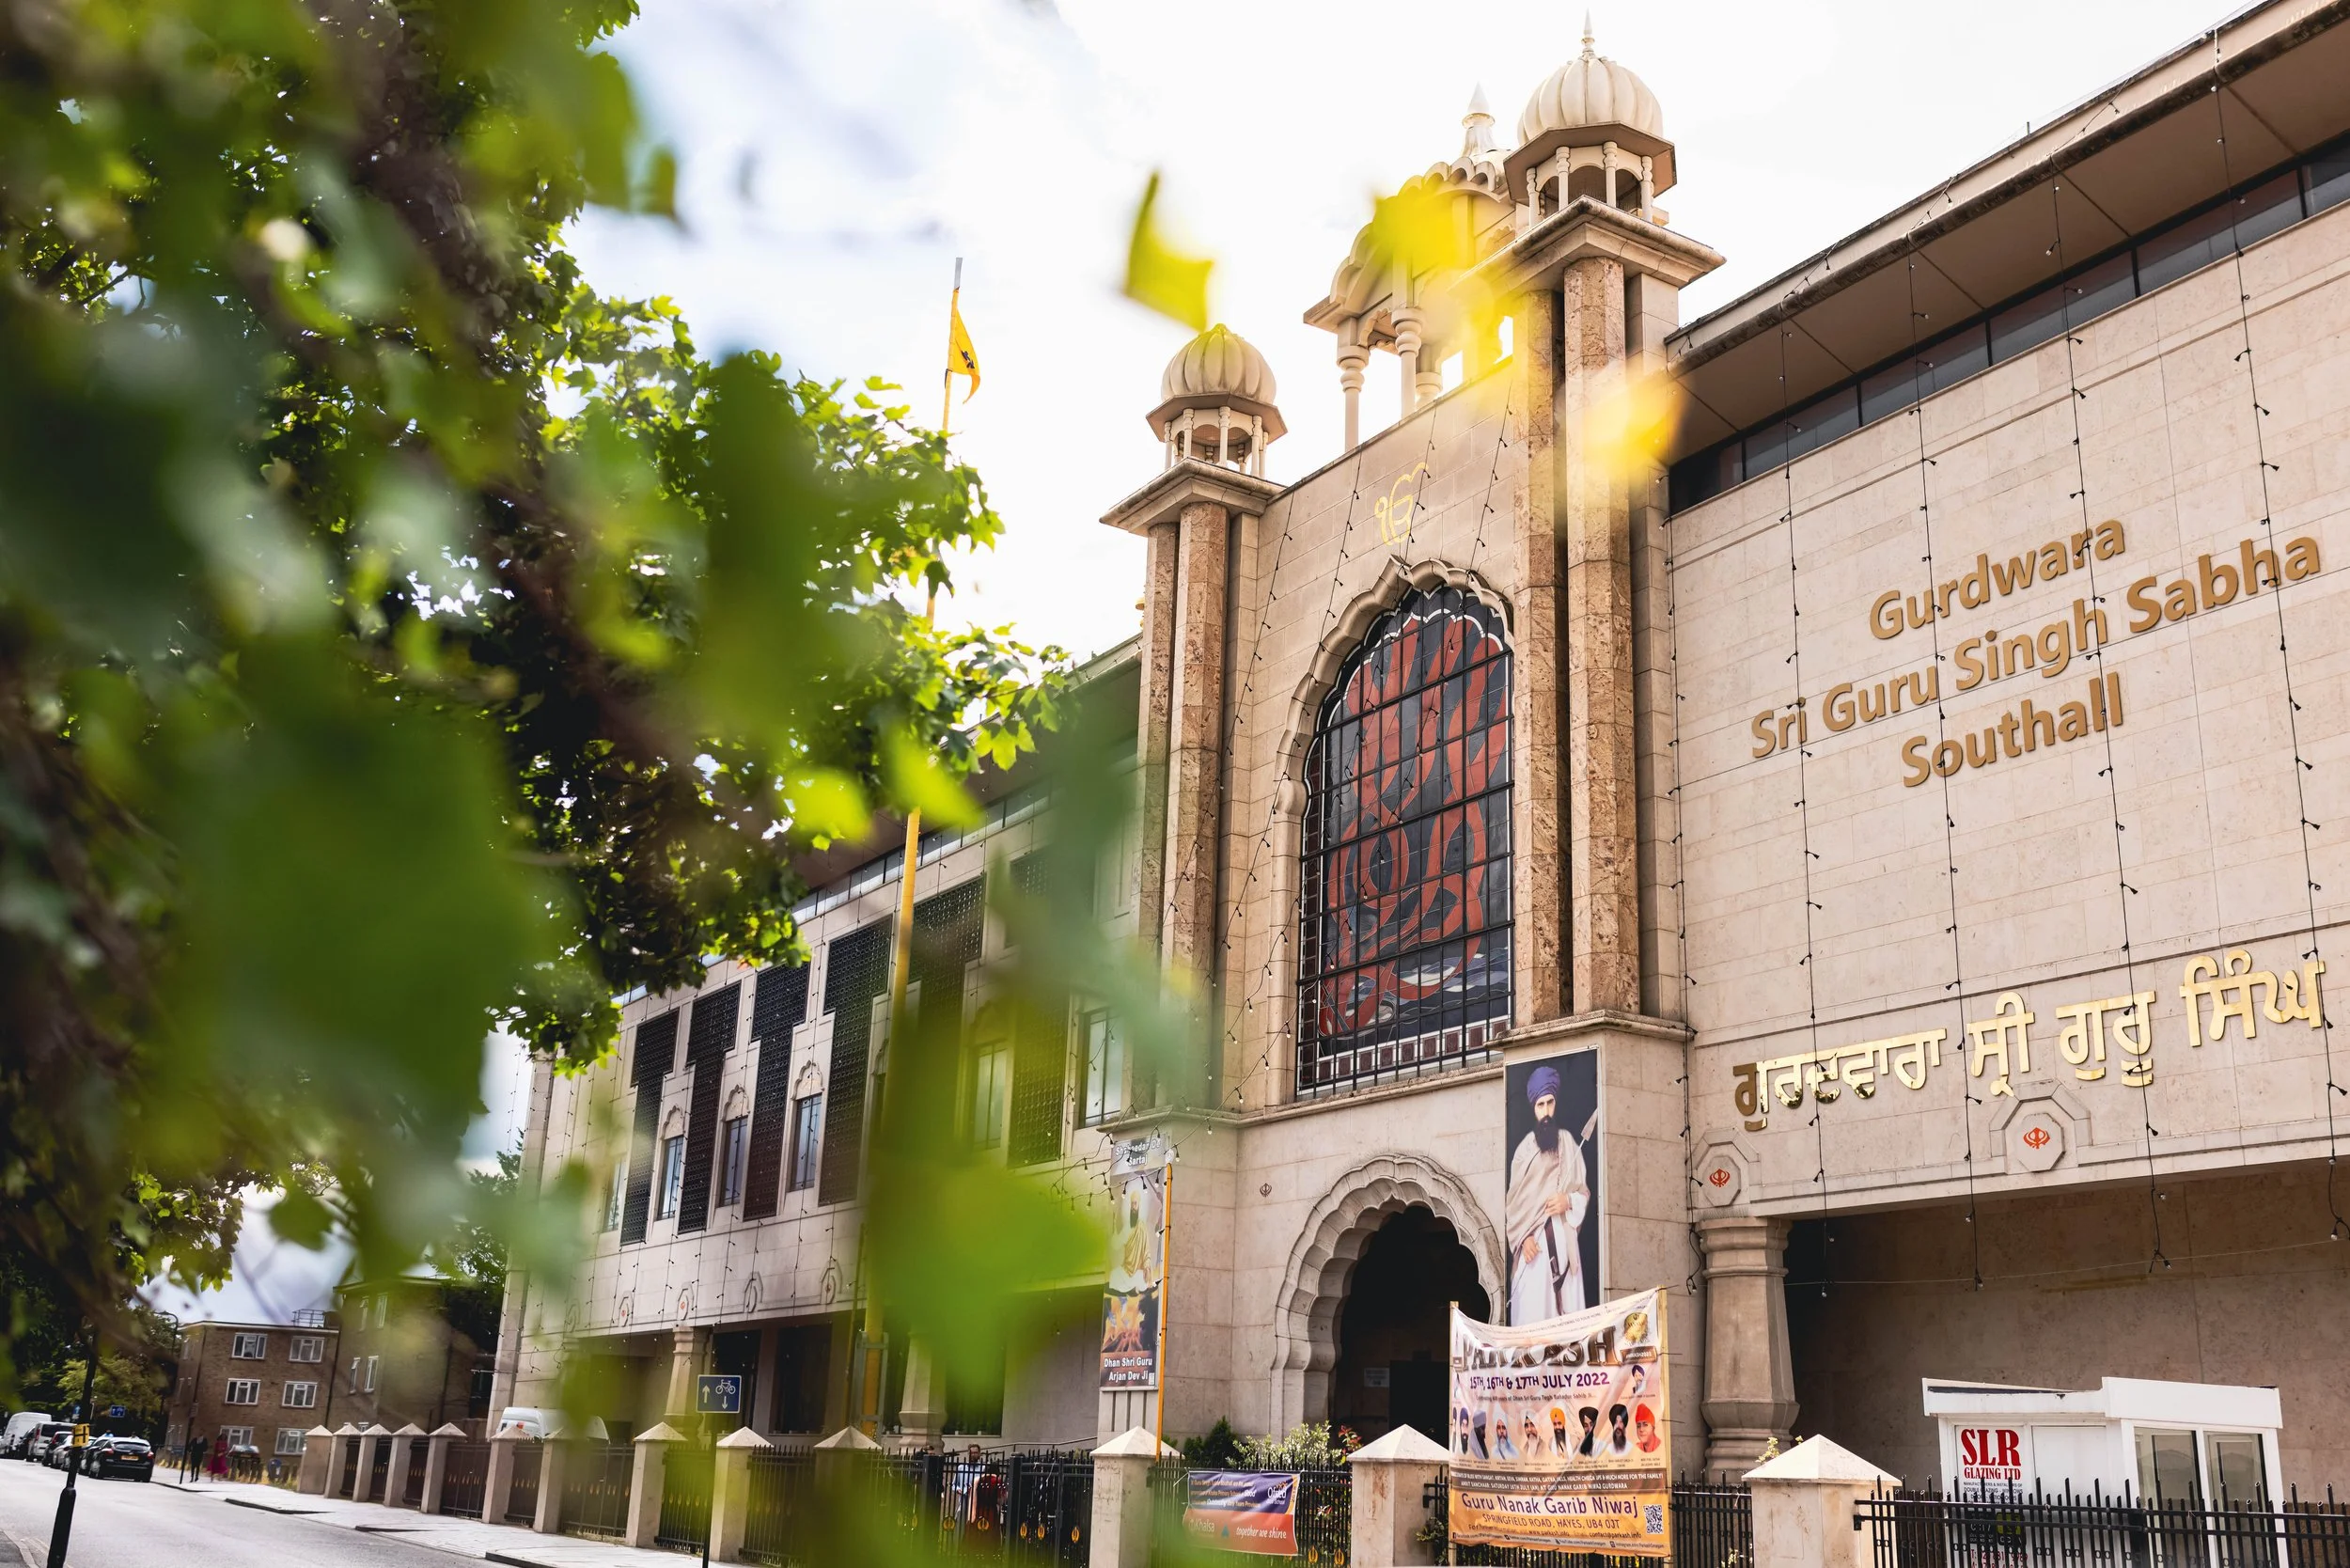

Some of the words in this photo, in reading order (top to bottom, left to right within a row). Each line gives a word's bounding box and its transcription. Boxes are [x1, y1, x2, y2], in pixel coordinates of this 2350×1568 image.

[1869, 519, 2126, 639] Gurdwara
[1751, 697, 1807, 759] Sri
[1822, 664, 1939, 732] Guru
[1954, 598, 2108, 691] Singh
[2126, 536, 2321, 634] Sabha
[1902, 671, 2123, 787] Southall
[2056, 991, 2156, 1088] ਗੁਰੂ
[2178, 949, 2326, 1047] ਸਿੰਘ
[1128, 1154, 1148, 1165] Sartaj
[1104, 1358, 1120, 1367] Dhan
[1122, 1357, 1135, 1366] Shri
[1137, 1356, 1152, 1366] Guru
[1109, 1371, 1126, 1383] Arjan
[1128, 1371, 1140, 1380] Dev
[1142, 1370, 1148, 1380] Ji
[1470, 1377, 1485, 1390] 15TH,
[1487, 1377, 1504, 1389] 16TH
[1506, 1377, 1513, 1389] &
[1515, 1376, 1539, 1389] 17TH
[1542, 1375, 1572, 1388] JULY
[1576, 1372, 1610, 1387] 2022
[1961, 1429, 2021, 1466] SLR
[1964, 1467, 2001, 1480] GLAZING
[2004, 1468, 2021, 1481] LTD
[1462, 1493, 1494, 1510] Guru
[1497, 1495, 1541, 1513] Nanak
[1544, 1497, 1587, 1513] Garib
[1592, 1497, 1638, 1518] Niwaj
[1195, 1520, 1215, 1533] Khalsa
[1482, 1514, 1527, 1526] SPRINGFIELD
[1529, 1519, 1555, 1528] ROAD,
[1556, 1519, 1585, 1529] HAYES,
[1586, 1519, 1603, 1528] UB4
[1236, 1526, 1258, 1538] together
[1269, 1527, 1286, 1538] shine
